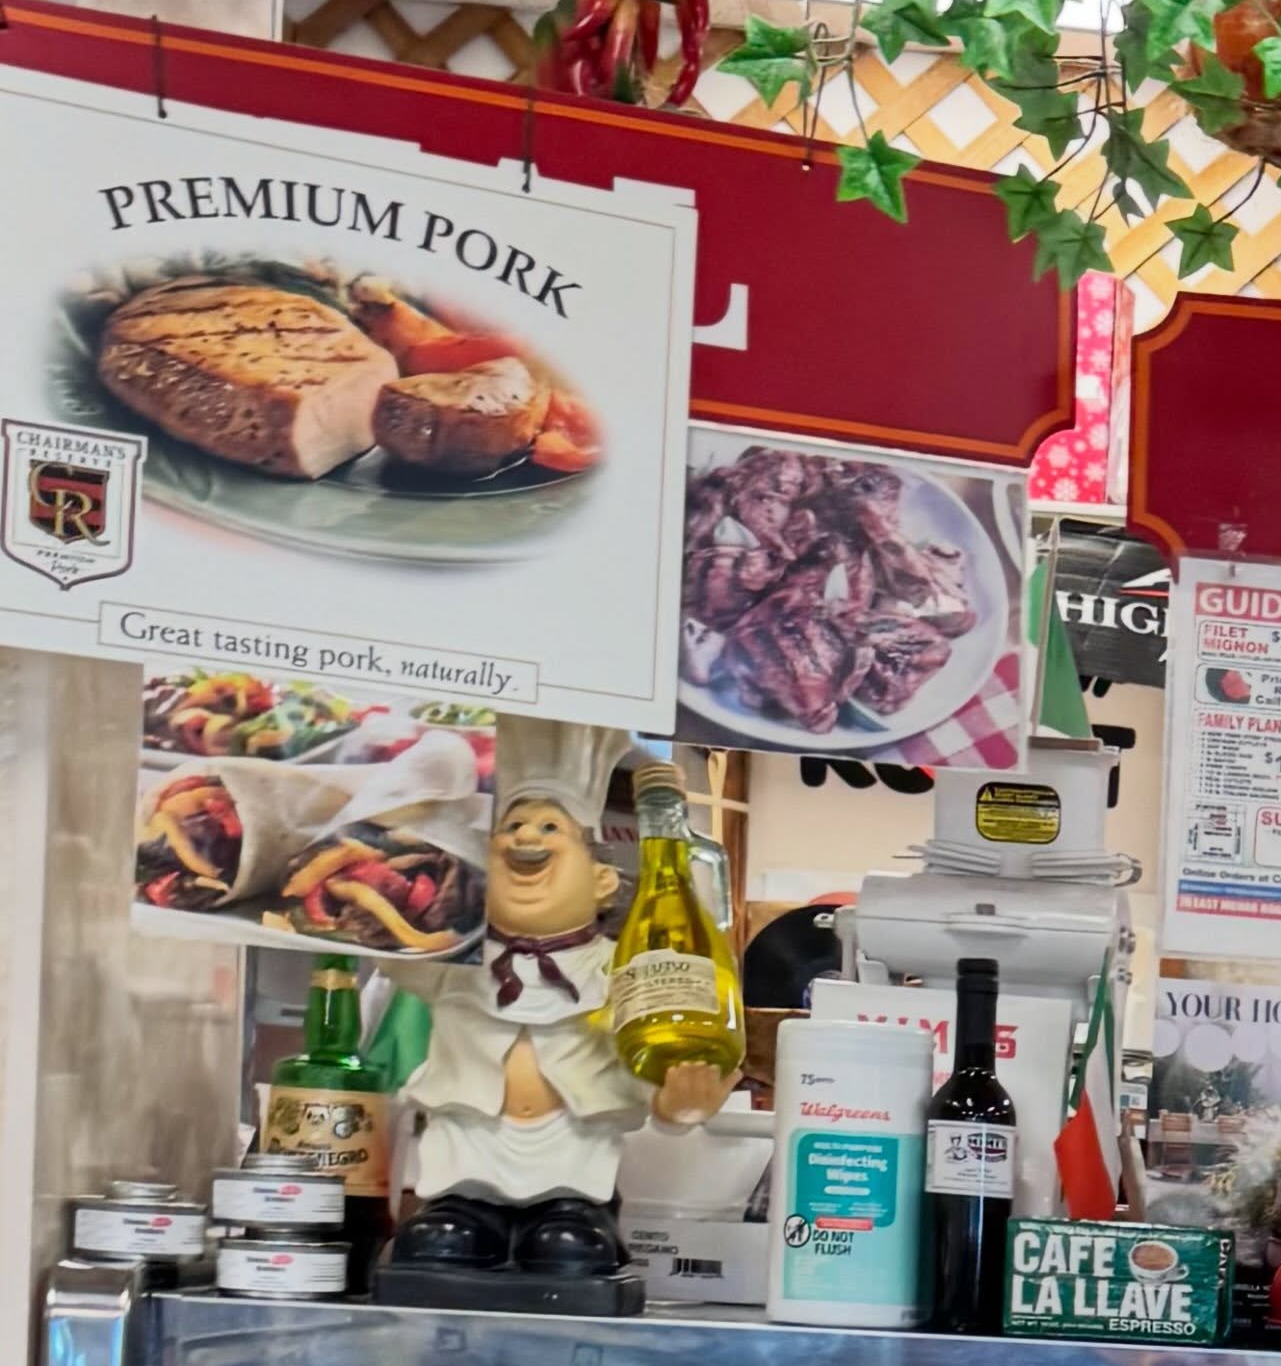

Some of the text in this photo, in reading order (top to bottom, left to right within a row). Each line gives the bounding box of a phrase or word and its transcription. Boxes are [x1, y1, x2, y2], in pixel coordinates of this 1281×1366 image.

[100, 175, 582, 319] PREMIUM PORK
[17, 431, 126, 460] CHAIRMAN'S
[1203, 623, 1248, 638] FILET
[120, 611, 519, 693] Great tasting pork, naturally.
[1203, 639, 1269, 655] MIGNON
[1166, 991, 1242, 1021] YOUR
[800, 1102, 891, 1122] Walgreens
[808, 1153, 888, 1172] Disinfecting
[826, 1168, 869, 1184] Wipes
[812, 1229, 854, 1244] DO NOT
[815, 1243, 851, 1256] FLUSH
[1013, 1231, 1118, 1277] CAFE
[1011, 1274, 1194, 1322] LA LLAVE
[1109, 1318, 1197, 1336] ESPRESSO
